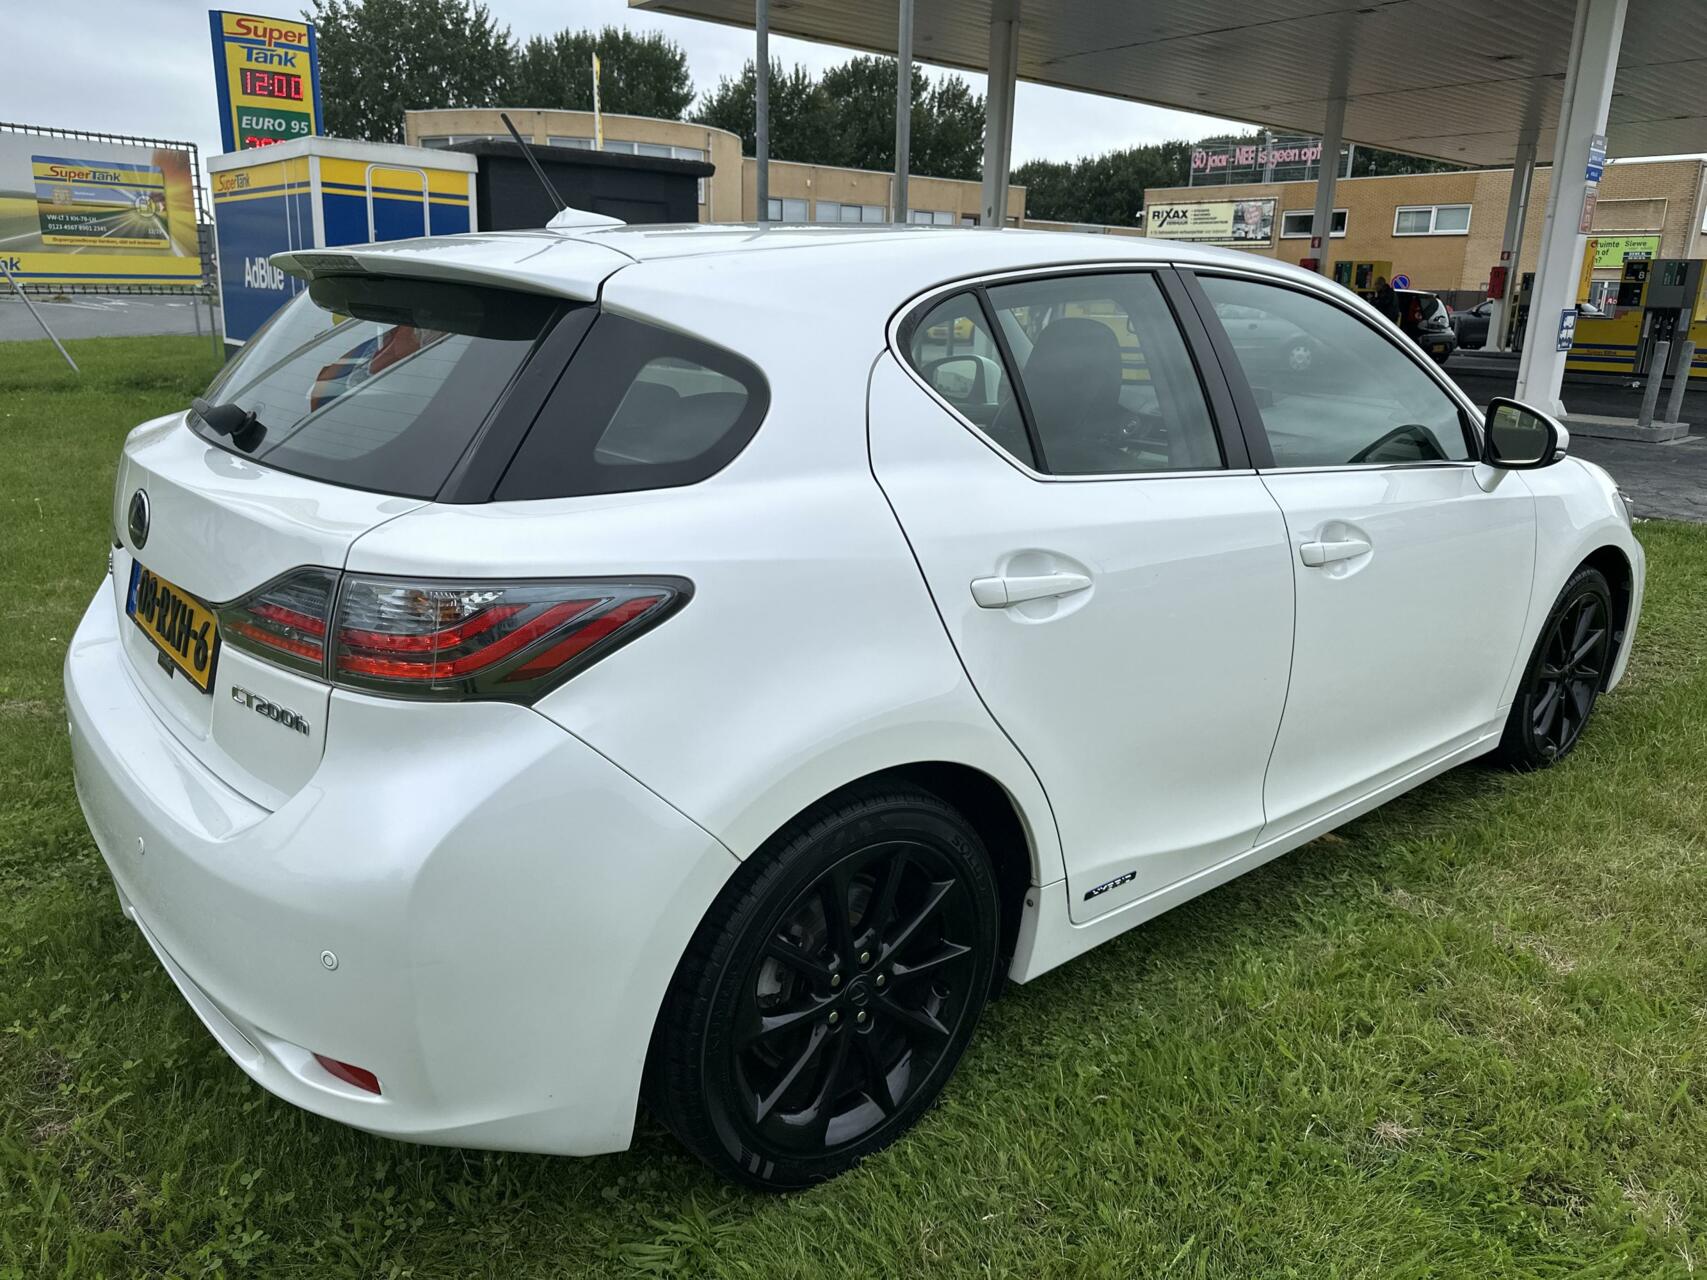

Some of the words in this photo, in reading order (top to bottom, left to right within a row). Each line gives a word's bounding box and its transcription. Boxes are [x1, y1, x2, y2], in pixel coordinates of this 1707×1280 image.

[224, 18, 306, 47] Super
[238, 45, 297, 68] Tank
[246, 71, 303, 99] 12:00
[241, 116, 286, 131] EURO
[290, 121, 309, 134] 95
[1206, 152, 1229, 173] jaar
[1235, 146, 1256, 166] NEE
[1258, 148, 1267, 164] is
[1269, 149, 1298, 168] geen
[45, 165, 121, 183] SuperTank
[1152, 208, 1189, 227] RIXAX
[245, 257, 285, 290] AdBlue
